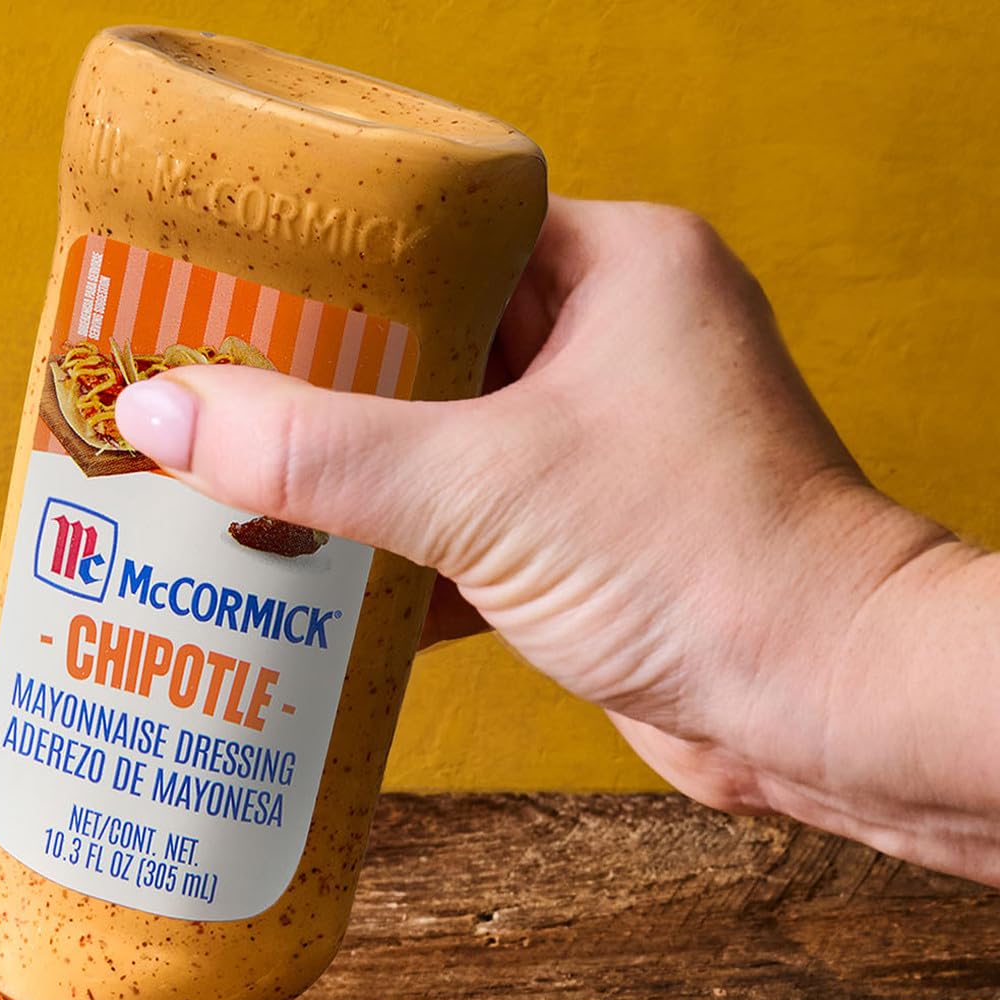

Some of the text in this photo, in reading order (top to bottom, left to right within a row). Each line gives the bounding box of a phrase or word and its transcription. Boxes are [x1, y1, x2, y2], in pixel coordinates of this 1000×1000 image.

[11, 672, 296, 786] MAYONNAISE DRESSING
[66, 614, 280, 732] CHIPOTLE
[2, 716, 284, 828] ADEREZO DE MAYONESA
[44, 827, 218, 905] 10.3 FL OZ (305 mL)
[68, 804, 200, 867] NET/CONT. NET.
